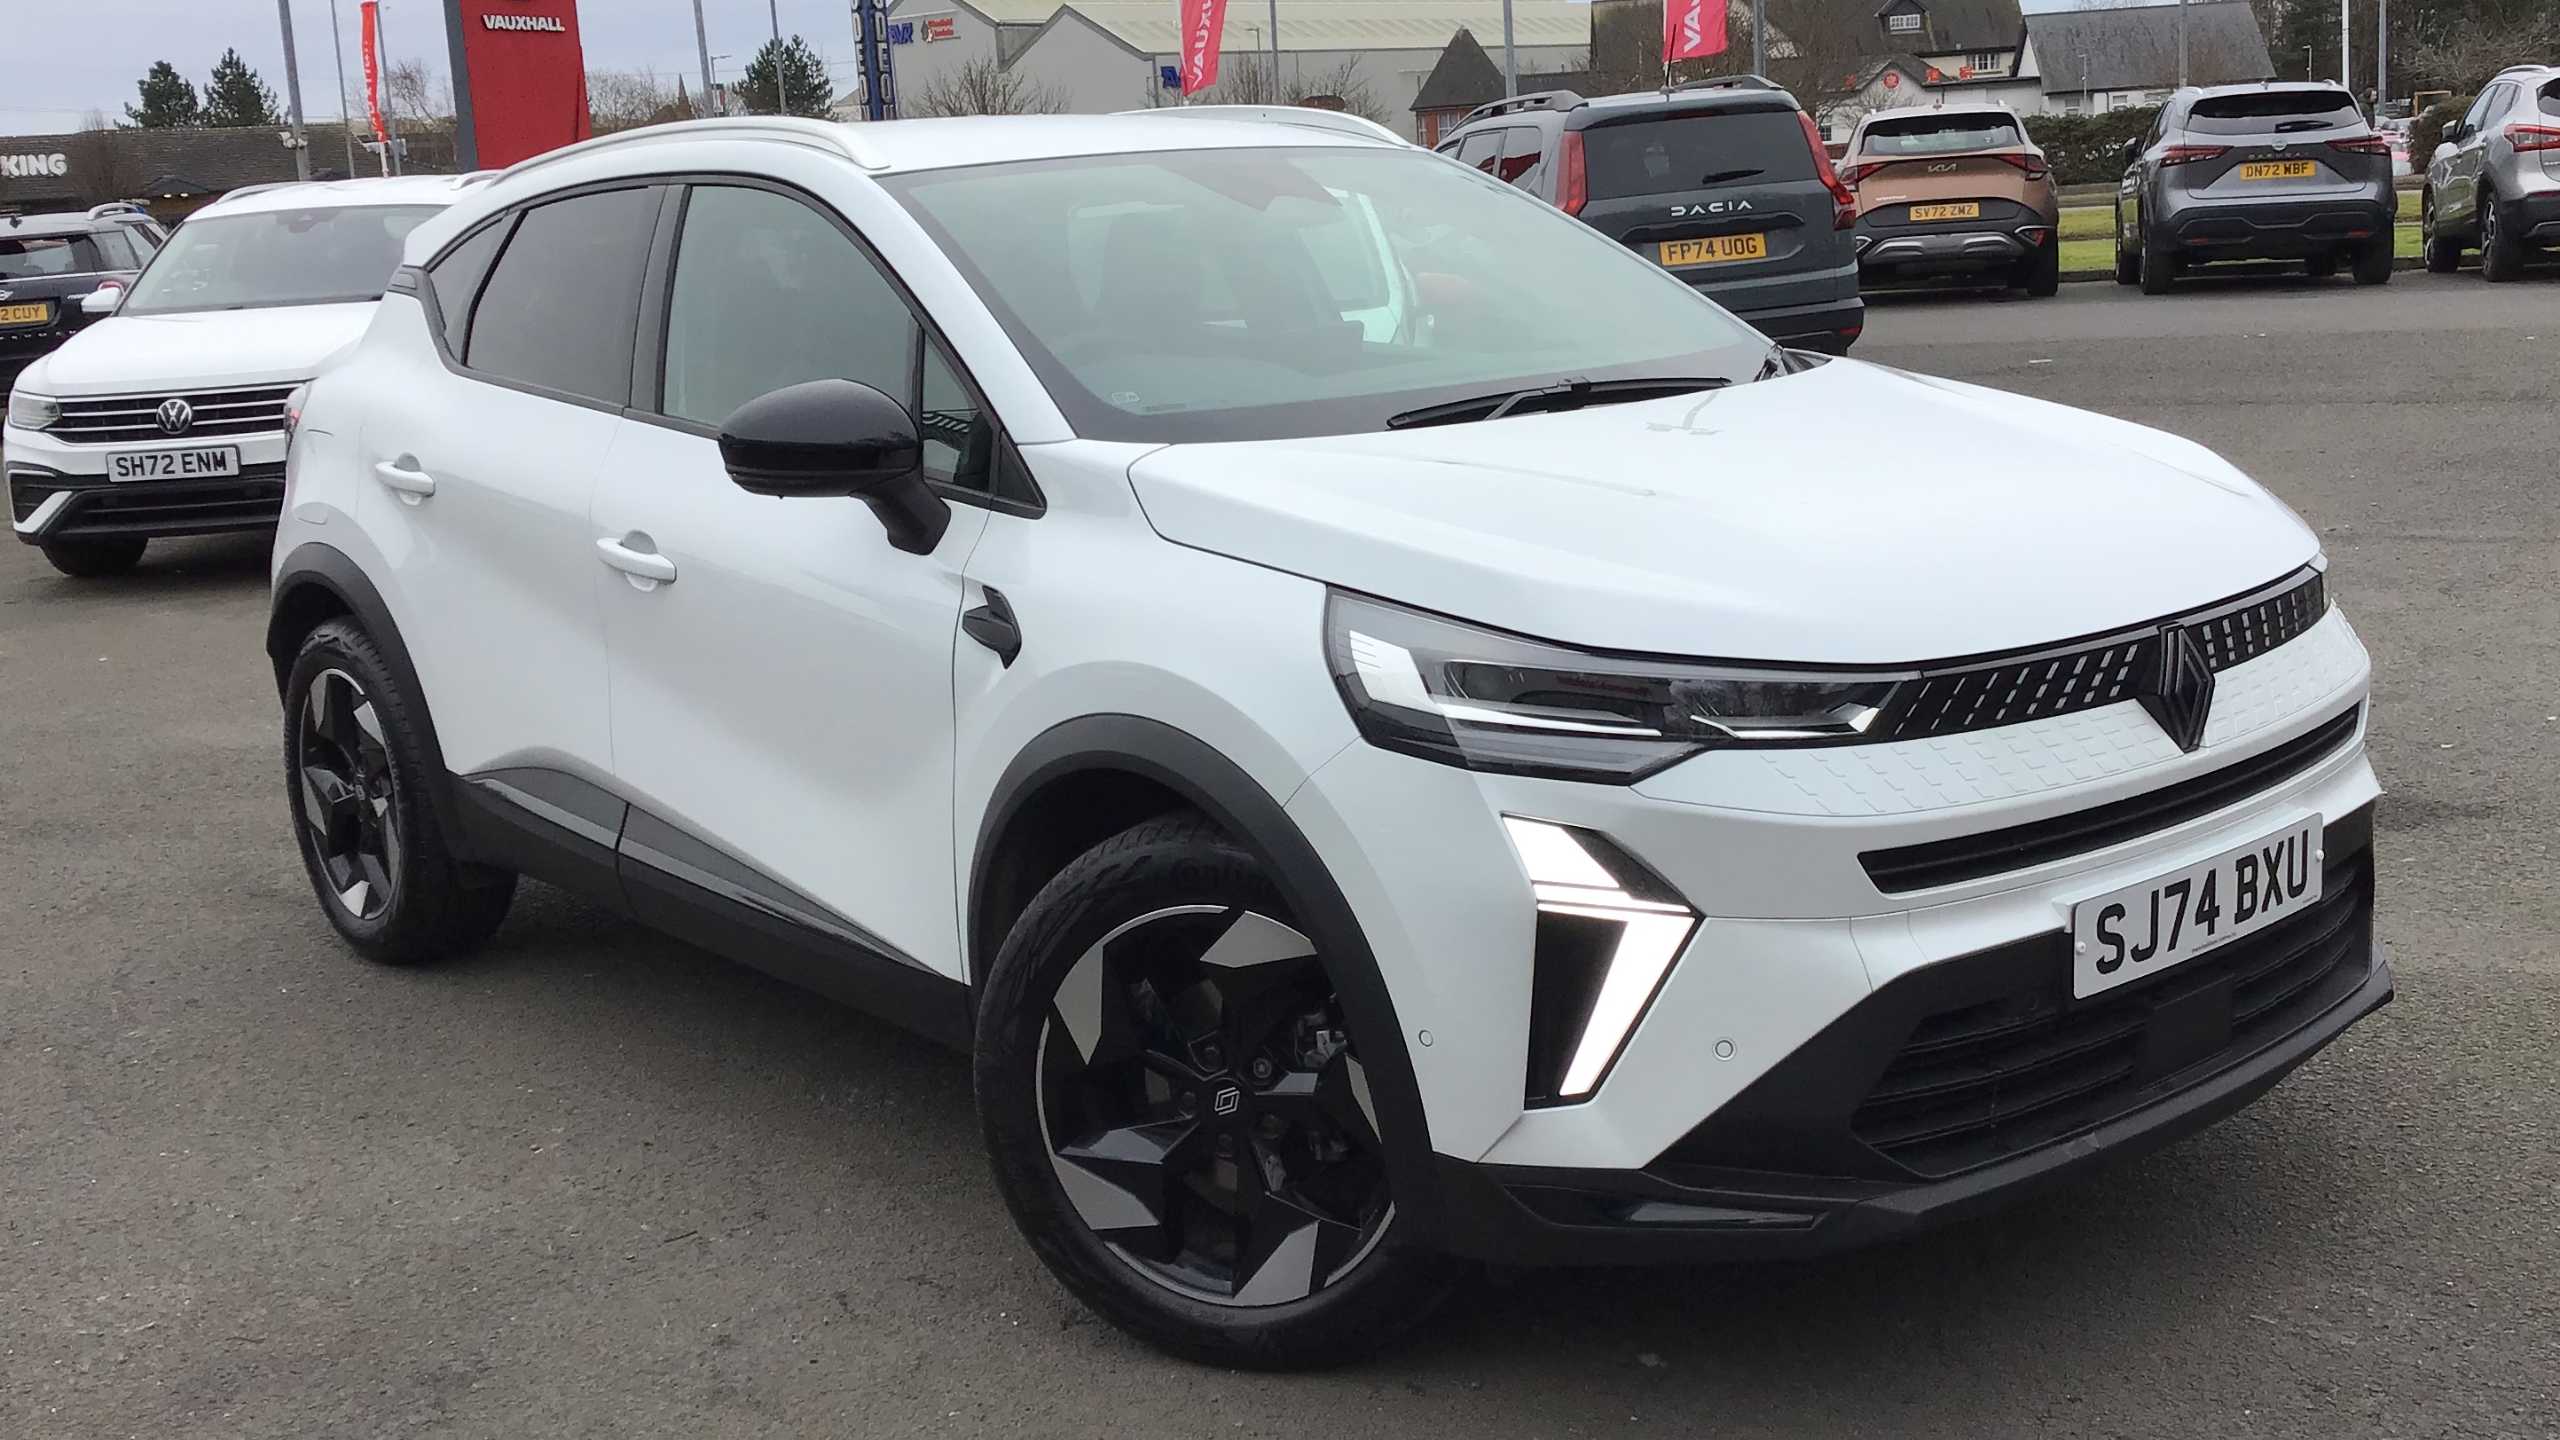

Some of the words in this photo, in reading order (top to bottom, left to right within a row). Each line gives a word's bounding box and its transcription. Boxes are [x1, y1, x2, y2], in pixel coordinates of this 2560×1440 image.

[482, 14, 565, 32] VAUXHALL
[1683, 0, 1702, 54] VA
[0, 153, 67, 176] KING
[2245, 164, 2280, 177] DN72
[1670, 200, 1752, 217] DACIA
[1915, 206, 1946, 219] SV72
[1667, 240, 1715, 261] FP74
[12, 306, 41, 319] CUY
[116, 454, 176, 477] SH72
[181, 451, 227, 474] ENM
[2095, 868, 2221, 975] SJ74
[2234, 829, 2309, 925] BXU
